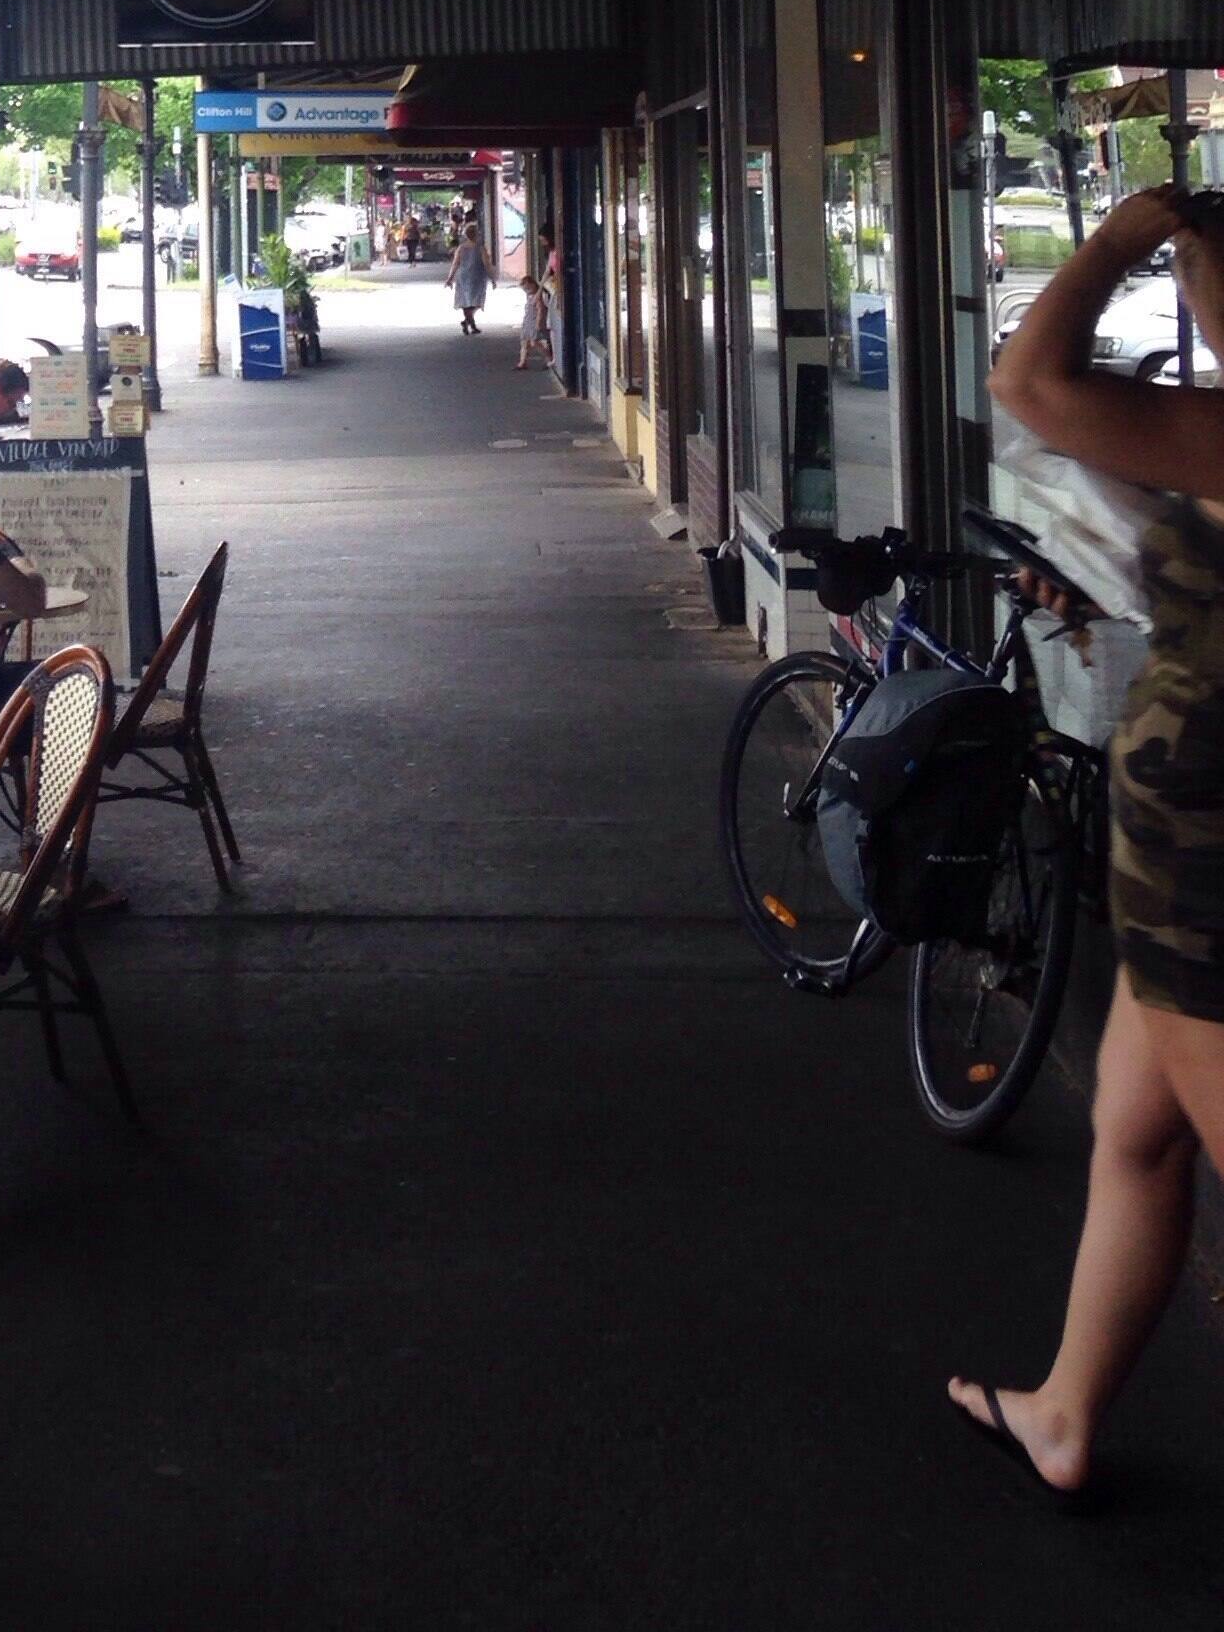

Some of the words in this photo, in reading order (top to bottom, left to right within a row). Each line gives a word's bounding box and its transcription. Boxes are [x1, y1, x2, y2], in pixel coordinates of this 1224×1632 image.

[196, 106, 233, 118] Clifton
[234, 105, 253, 117] Hill
[294, 107, 379, 124] Advantage
